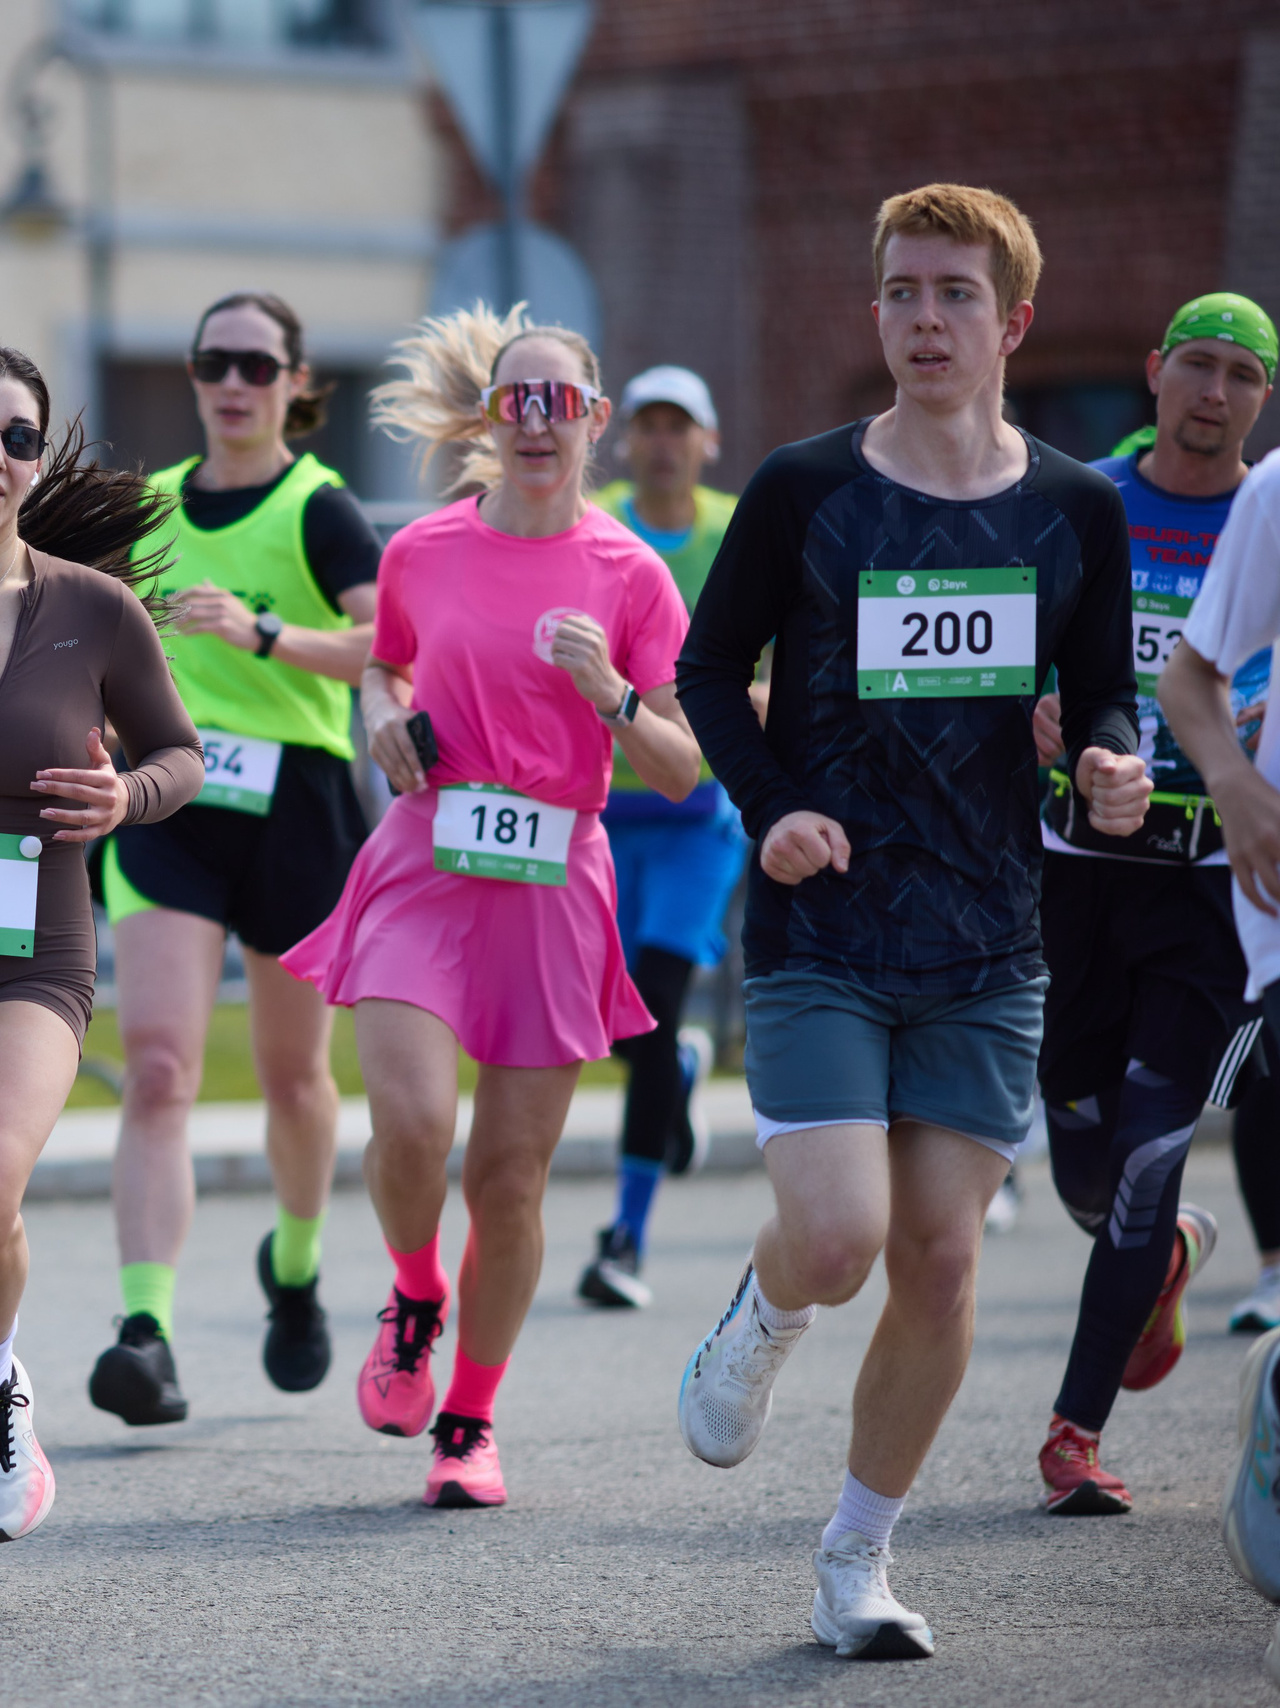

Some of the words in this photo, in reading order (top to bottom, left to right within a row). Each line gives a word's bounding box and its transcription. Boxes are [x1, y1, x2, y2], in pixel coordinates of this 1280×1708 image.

[1147, 546, 1212, 566] TEAM
[942, 580, 967, 591] Звук
[902, 610, 992, 656] 200
[53, 639, 79, 650] yougo
[892, 672, 908, 692] A
[471, 805, 539, 848] 181
[457, 852, 470, 870] A
